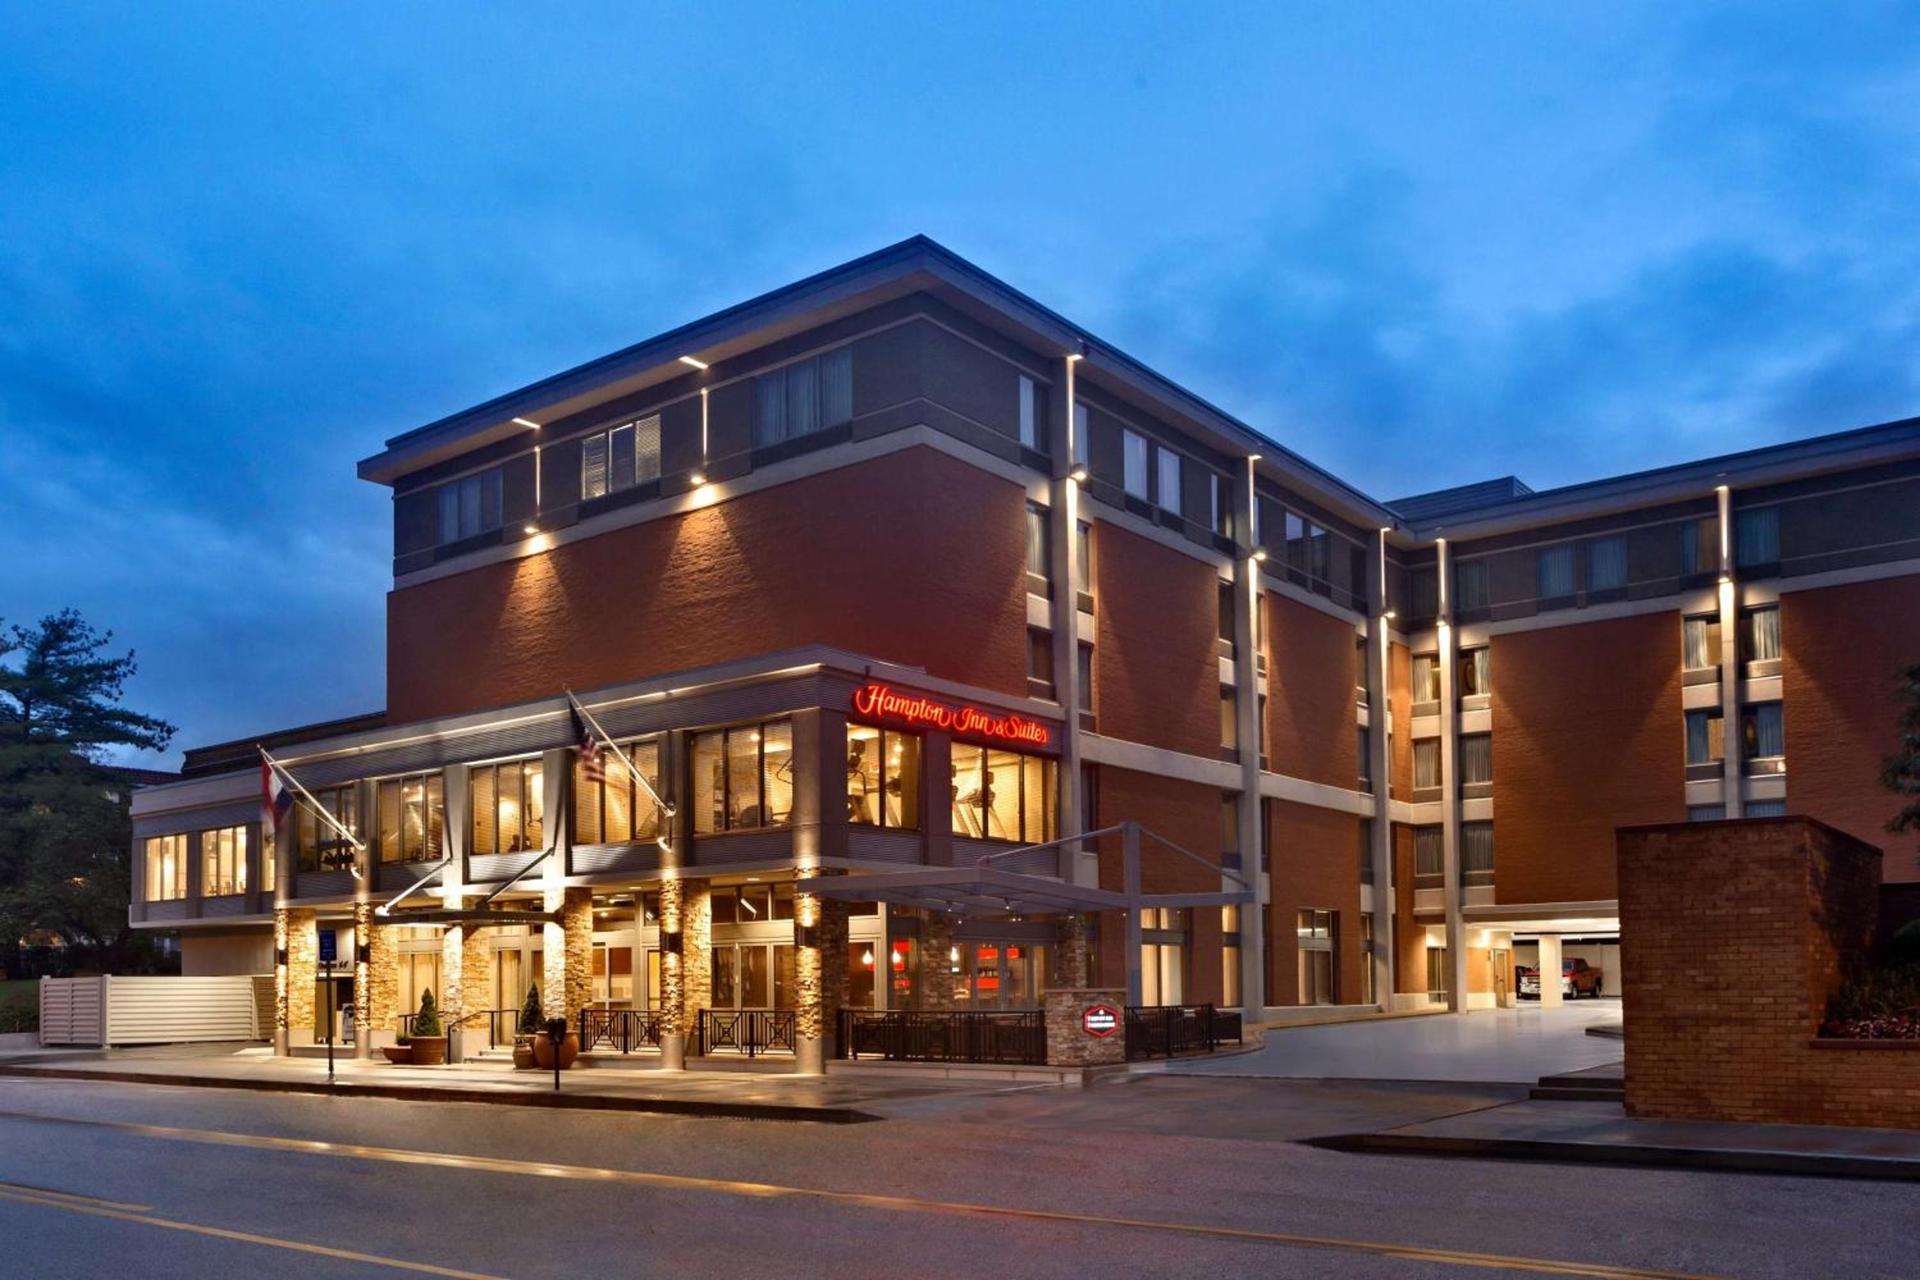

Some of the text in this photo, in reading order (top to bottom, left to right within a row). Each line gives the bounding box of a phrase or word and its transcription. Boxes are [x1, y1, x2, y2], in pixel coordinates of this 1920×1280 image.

[855, 686, 1047, 743] Hampton Inn & Suites
